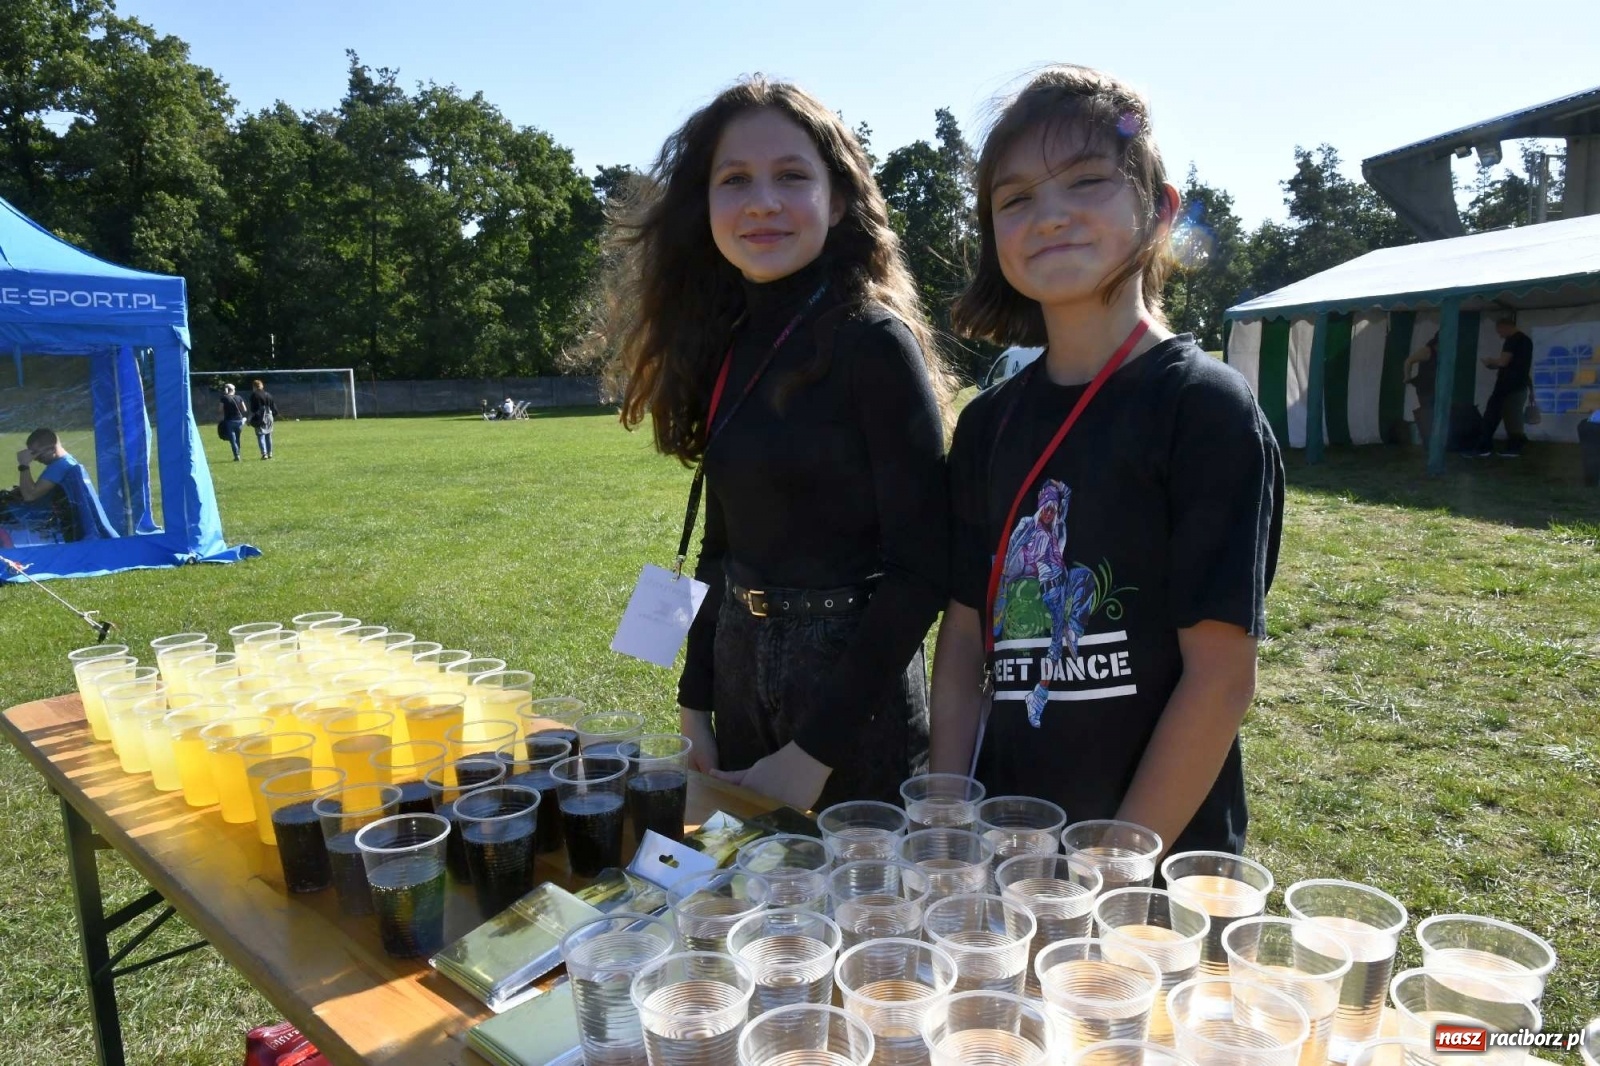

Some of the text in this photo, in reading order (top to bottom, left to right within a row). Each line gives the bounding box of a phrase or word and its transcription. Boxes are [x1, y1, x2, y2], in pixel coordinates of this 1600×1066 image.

[0, 287, 167, 310] E-SPORT.PL
[994, 650, 1132, 682] EET DANCE
